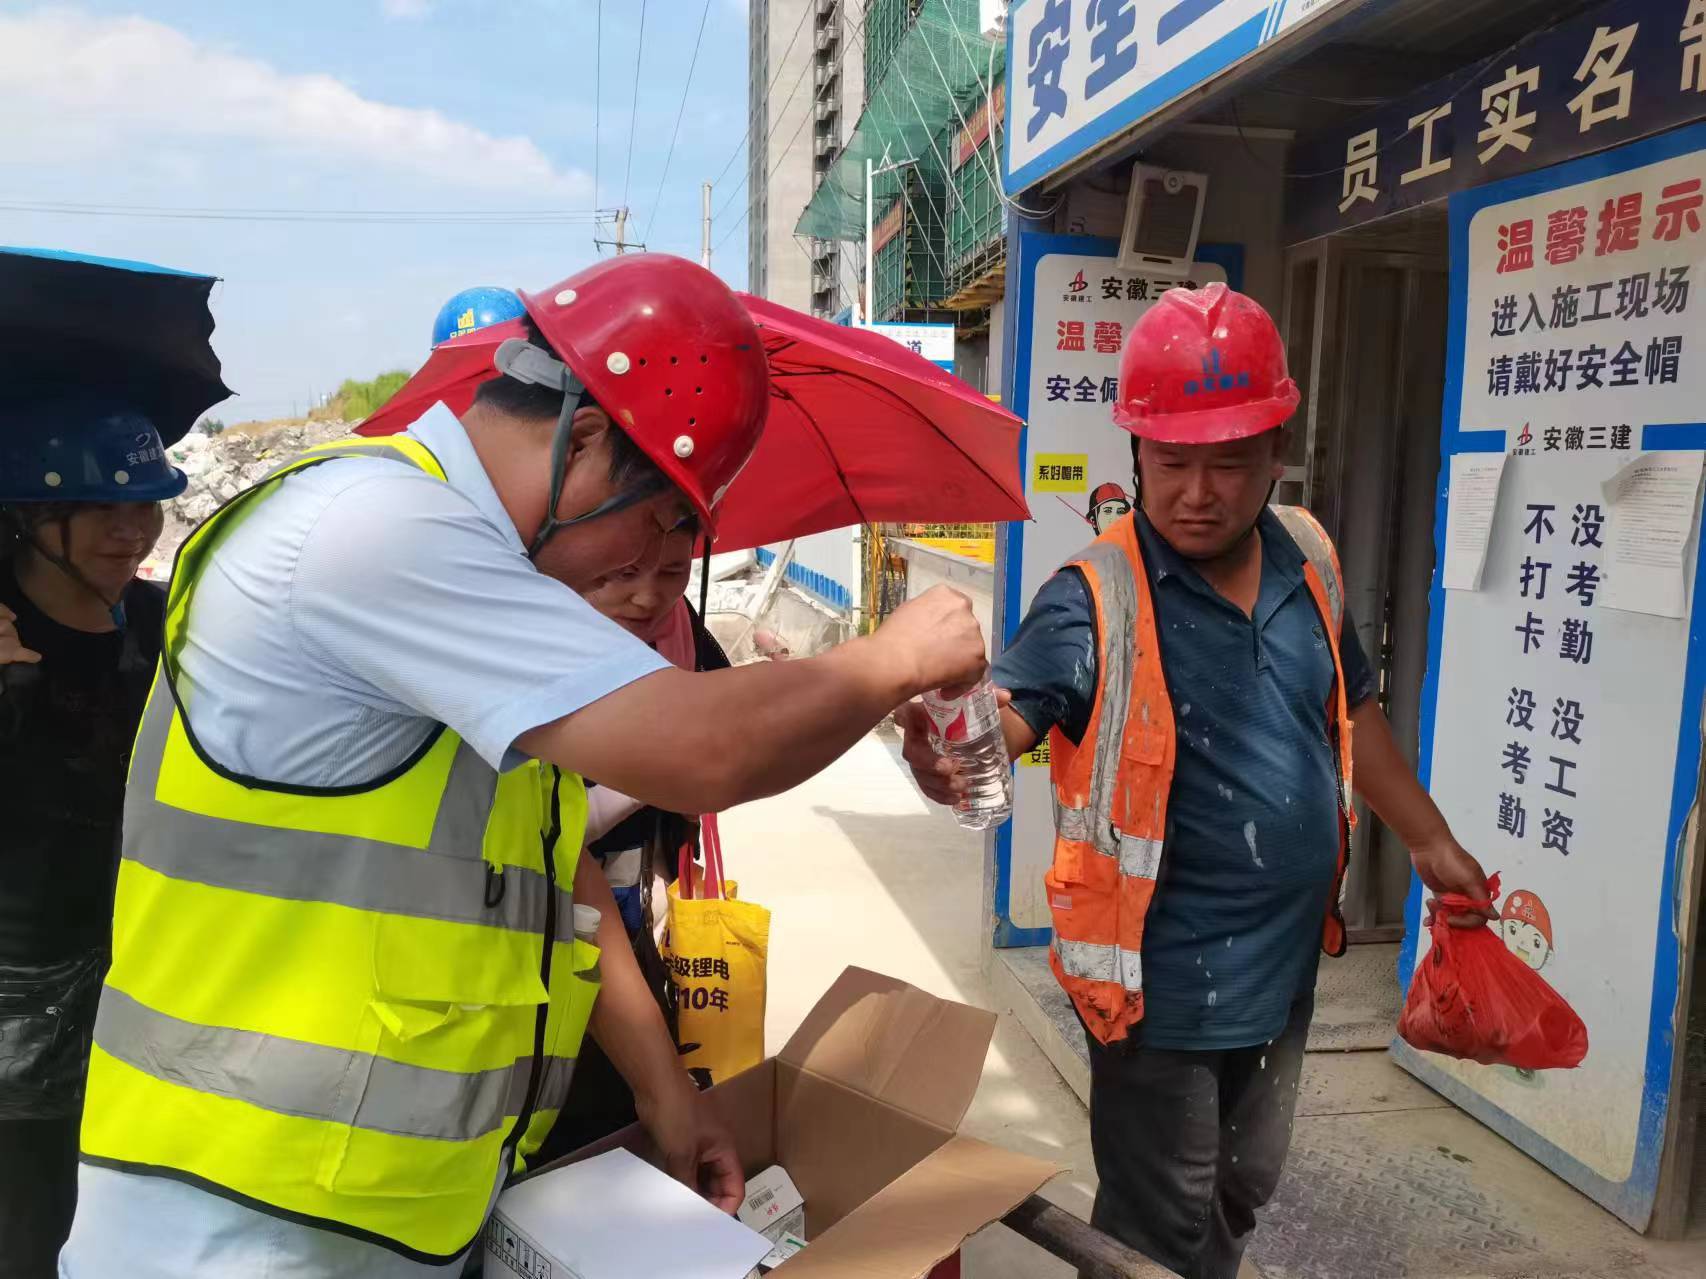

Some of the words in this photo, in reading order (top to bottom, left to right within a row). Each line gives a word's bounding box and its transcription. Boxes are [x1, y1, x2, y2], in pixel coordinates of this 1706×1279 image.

[1496, 178, 1704, 275] 温馨提示
[1490, 265, 1691, 338] 进入施工现场
[1056, 320, 1123, 354] 温馨
[1487, 335, 1683, 397] 请戴好安全帽
[1543, 423, 1633, 451] 安徽三建
[1038, 465, 1084, 481] 系好帽带
